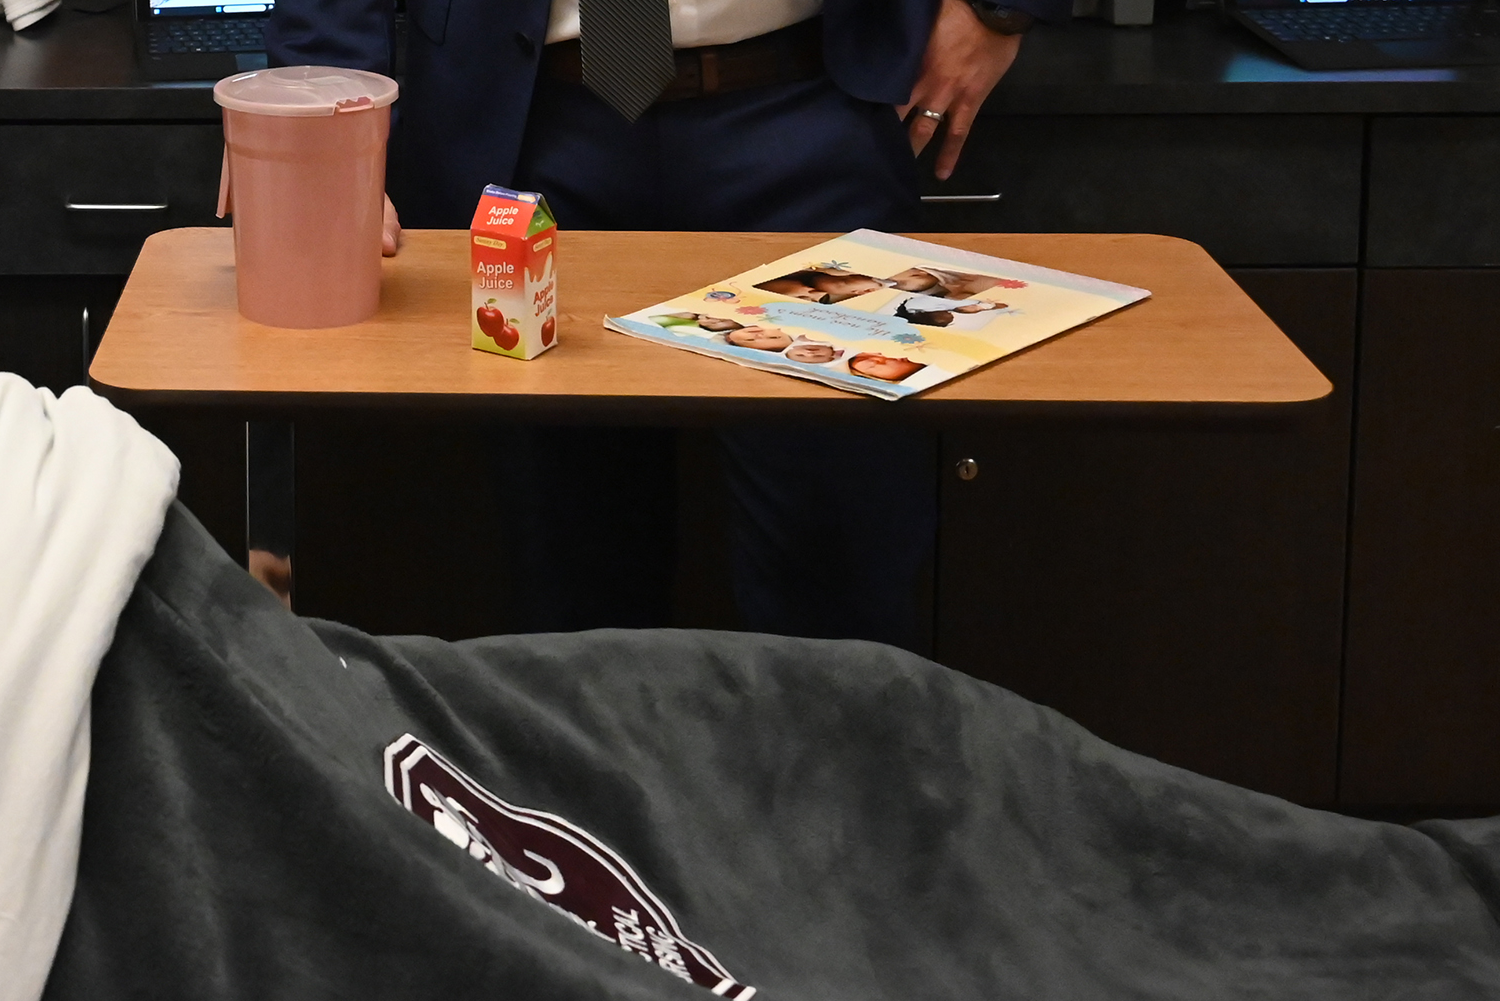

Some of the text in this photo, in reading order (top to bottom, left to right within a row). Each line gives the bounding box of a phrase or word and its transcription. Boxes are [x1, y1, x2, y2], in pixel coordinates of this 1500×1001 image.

[488, 206, 519, 217] Apple
[486, 216, 515, 225] Juice
[477, 261, 515, 277] Apple
[479, 277, 513, 289] Juice
[611, 905, 652, 963] TICAL
[646, 926, 694, 984] RSING
